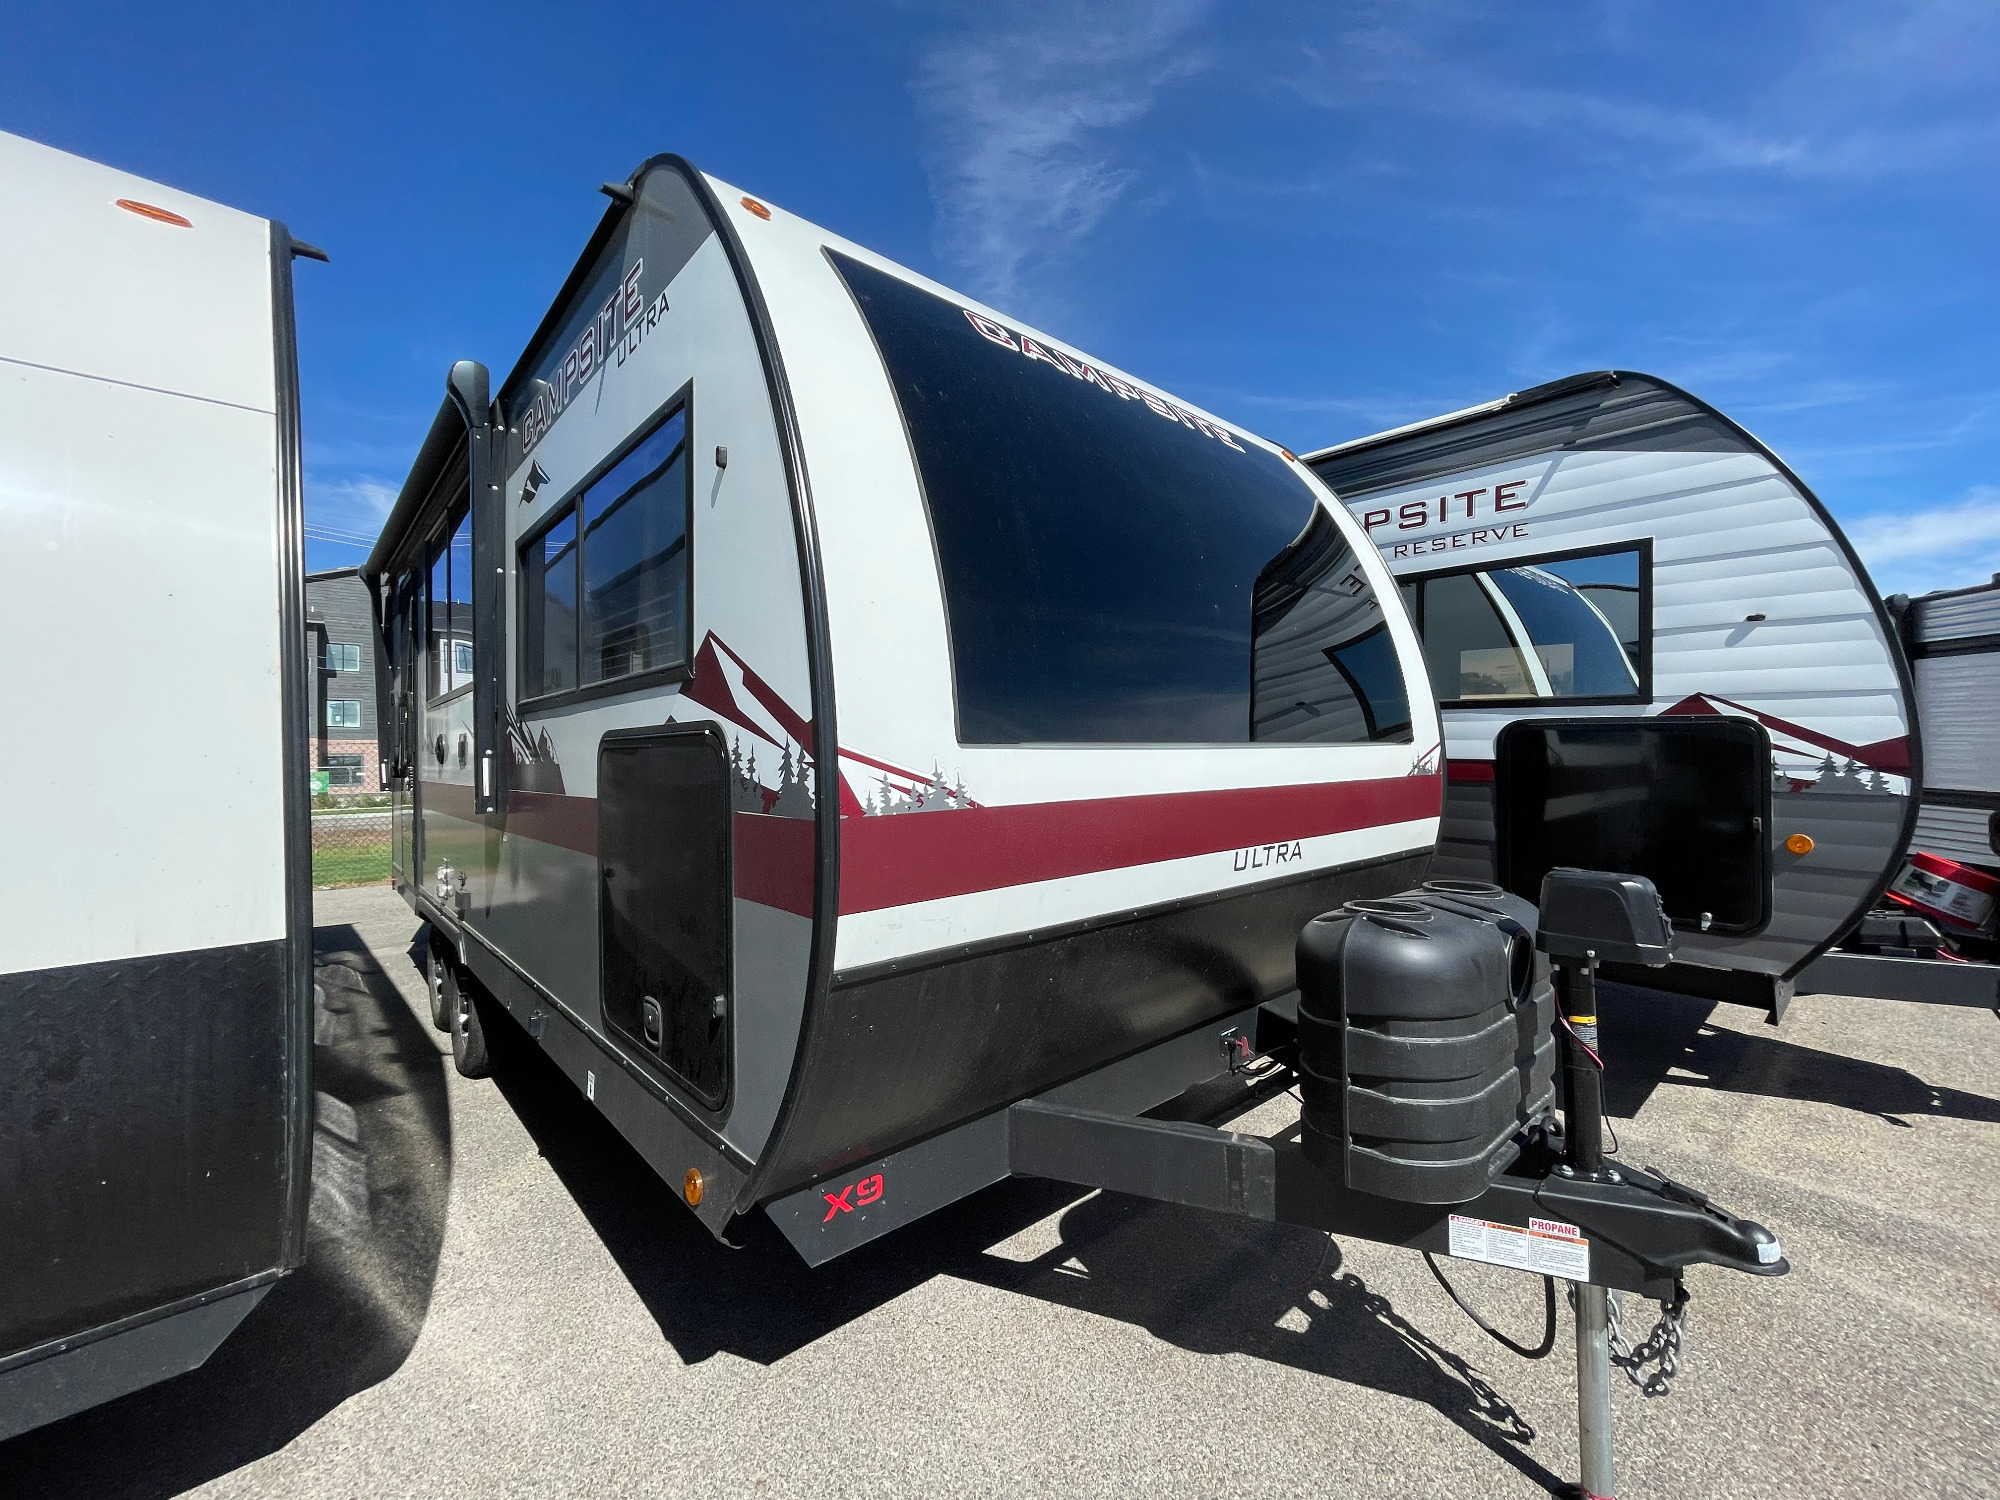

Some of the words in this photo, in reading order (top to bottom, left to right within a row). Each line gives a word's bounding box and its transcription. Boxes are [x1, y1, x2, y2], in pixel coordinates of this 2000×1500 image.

[522, 257, 644, 454] CAMPSITE
[616, 291, 670, 369] ULTRA
[962, 309, 1247, 454] CAMPSITE
[1363, 479, 1528, 535] PSITE
[1394, 522, 1530, 559] RESERVE
[1233, 841, 1302, 872] ULTRA
[823, 1173, 884, 1223] X9
[1531, 1220, 1578, 1237] PROPANE
